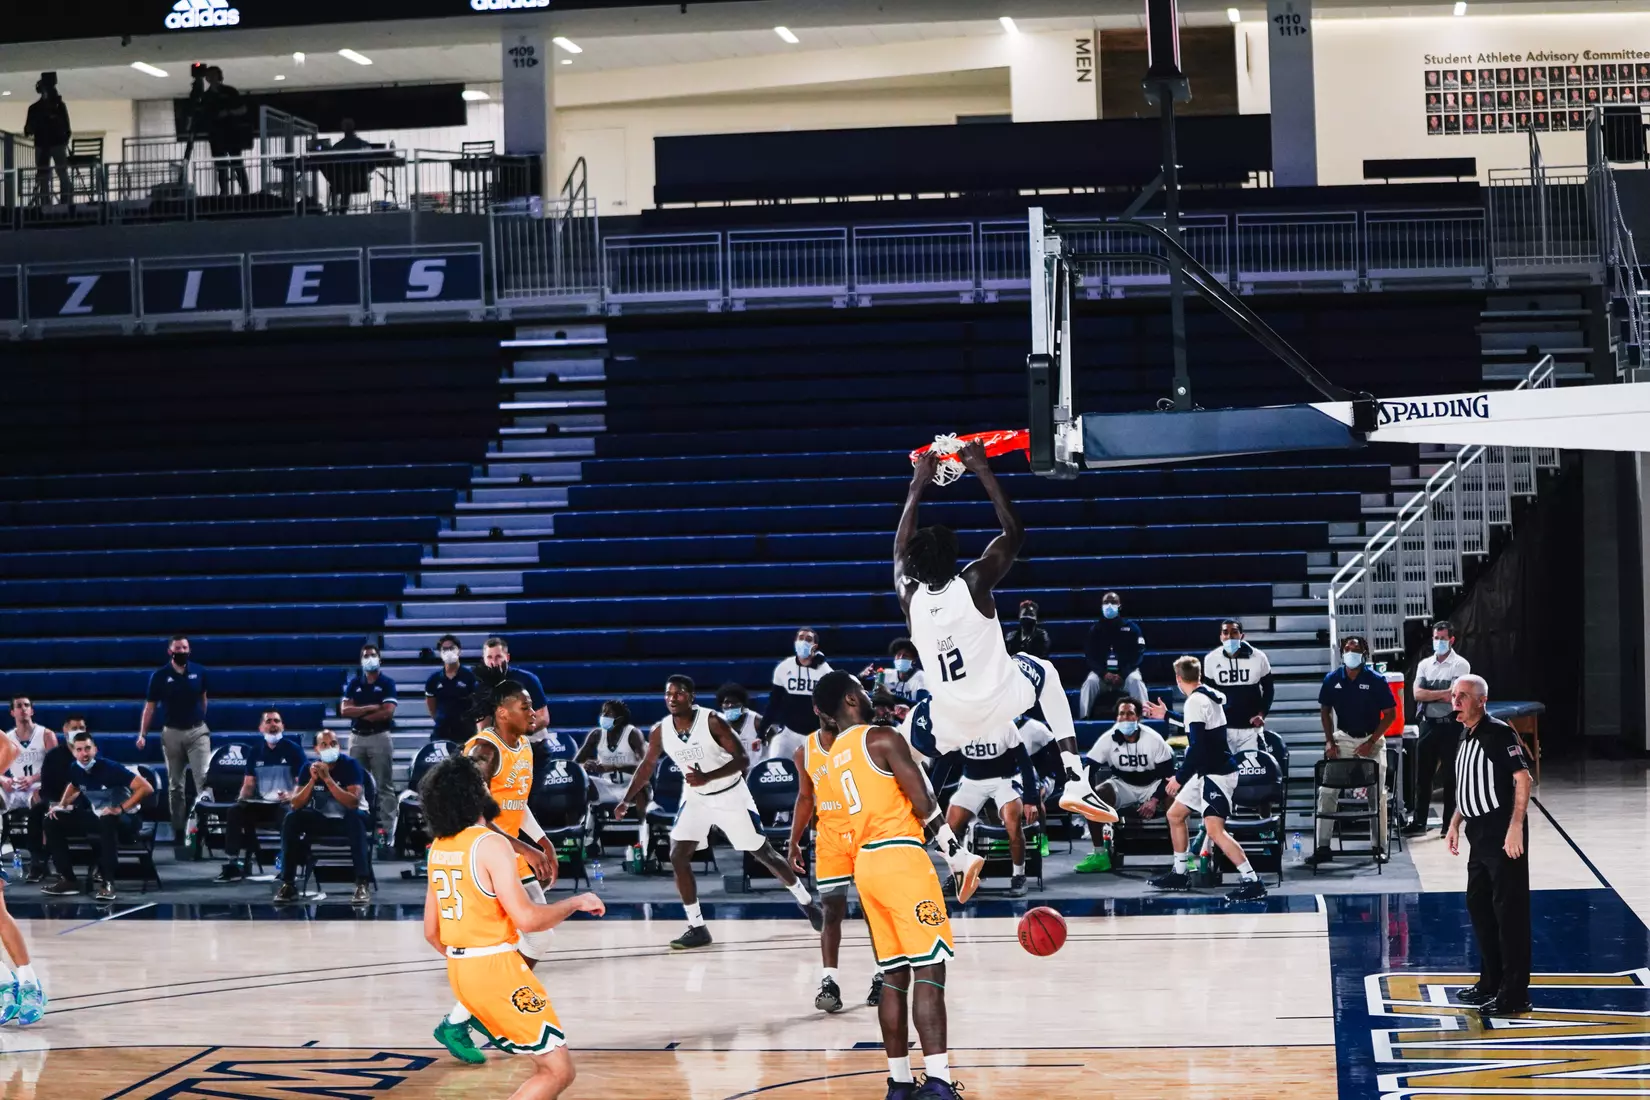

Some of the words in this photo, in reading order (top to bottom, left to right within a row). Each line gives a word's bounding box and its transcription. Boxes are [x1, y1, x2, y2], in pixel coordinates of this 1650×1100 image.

[165, 8, 240, 29] adidas
[1278, 14, 1301, 25] 110
[1279, 26, 1299, 36] 111
[514, 46, 534, 57] 109
[1424, 53, 1472, 65] Student
[1477, 52, 1522, 63] Athlete
[1526, 49, 1579, 63] Advisory
[1583, 49, 1650, 60] Committee
[1076, 38, 1092, 82] MEN
[1379, 395, 1489, 425] SPALDING
[938, 648, 966, 682] 12
[1219, 669, 1250, 683] CBU
[965, 743, 997, 757] CBU
[218, 758, 247, 766] adidas
[1119, 754, 1149, 768] CBU
[23, 765, 33, 776] 11
[760, 773, 793, 784] adidas
[841, 768, 862, 815] 0
[431, 869, 464, 921] 25
